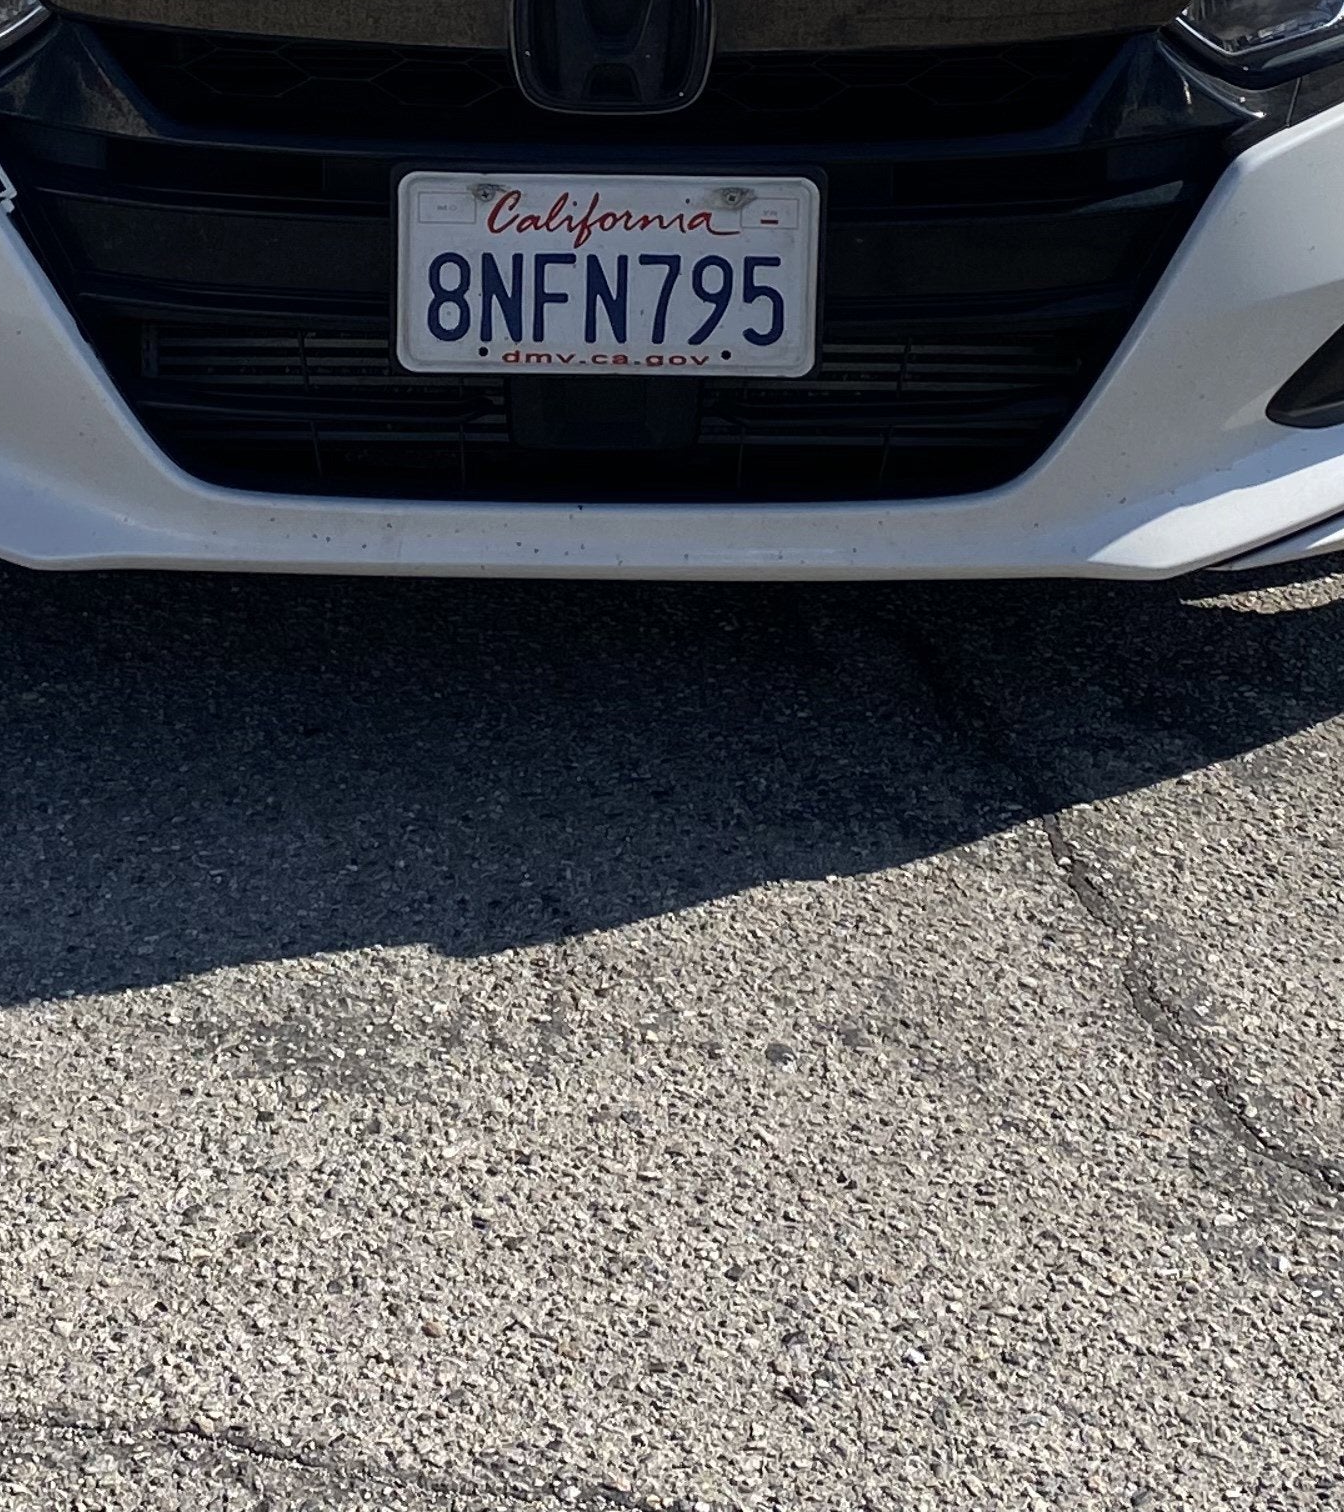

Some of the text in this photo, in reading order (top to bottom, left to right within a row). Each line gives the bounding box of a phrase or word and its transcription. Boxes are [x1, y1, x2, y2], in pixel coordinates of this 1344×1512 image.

[486, 190, 741, 249] California
[427, 251, 786, 346] 8NFN795
[502, 348, 710, 368] dmv.ca.gov
